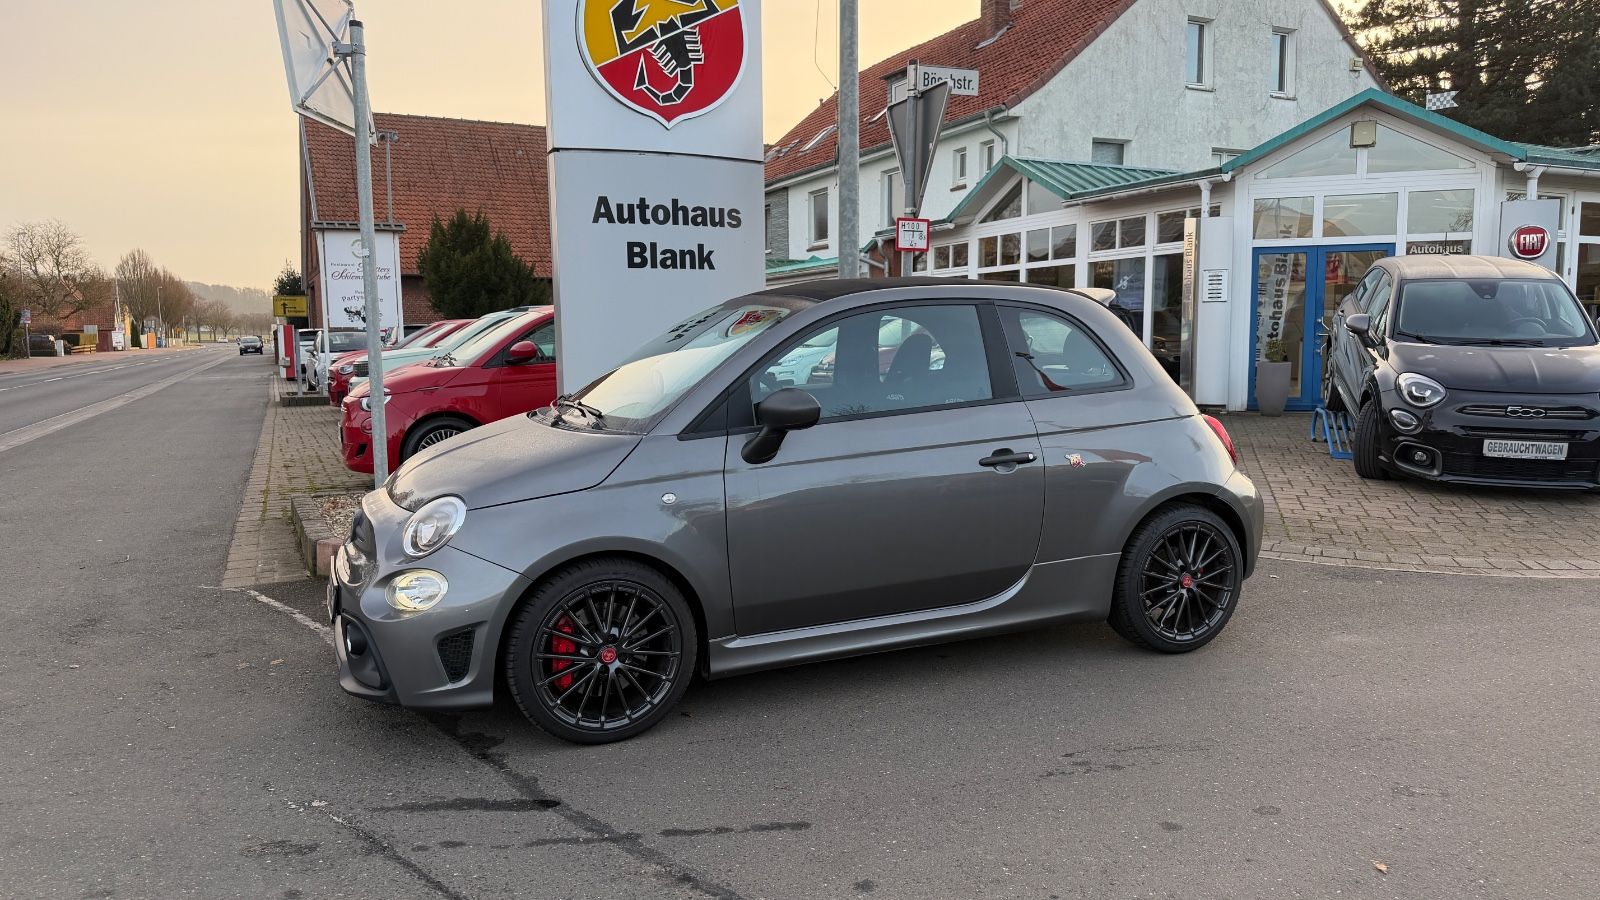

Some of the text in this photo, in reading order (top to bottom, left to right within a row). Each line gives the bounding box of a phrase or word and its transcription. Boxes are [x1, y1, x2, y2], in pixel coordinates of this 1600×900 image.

[923, 71, 974, 90] Böhstr.
[592, 195, 742, 229] Autohaus
[1185, 231, 1194, 257] Blank
[1409, 243, 1463, 255] Autohaus
[1519, 233, 1543, 251] FIAT
[626, 241, 716, 270] Blank
[1266, 277, 1287, 340] tohaus
[1506, 406, 1546, 417] 500
[1487, 441, 1564, 456] GEBRAUCHTWAGEN
